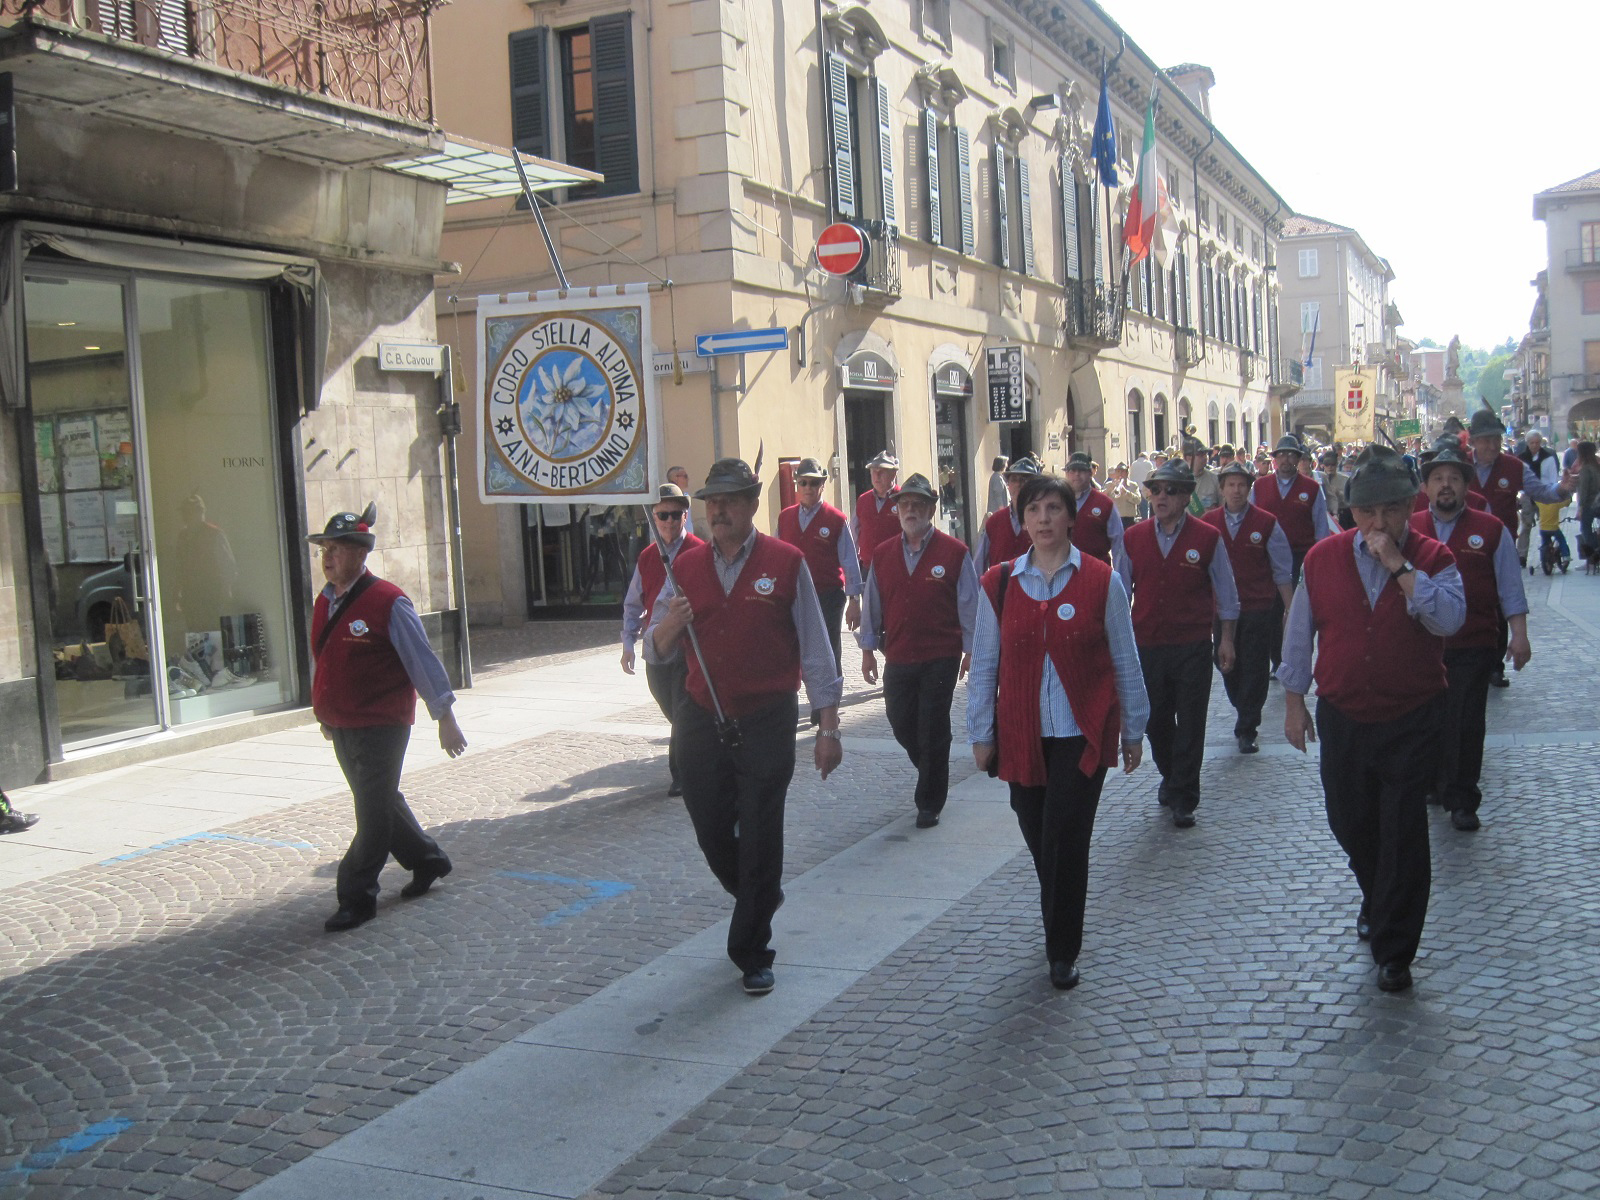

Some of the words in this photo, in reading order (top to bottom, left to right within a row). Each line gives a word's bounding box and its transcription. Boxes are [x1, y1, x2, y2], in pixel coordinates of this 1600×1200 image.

[405, 352, 434, 366] Cavour
[494, 348, 529, 405] CORO
[531, 321, 591, 350] STELLA
[595, 341, 636, 405] ALPINA
[652, 358, 689, 371] ornili
[1010, 353, 1020, 406] LOTTO
[222, 457, 265, 468] FIORINI
